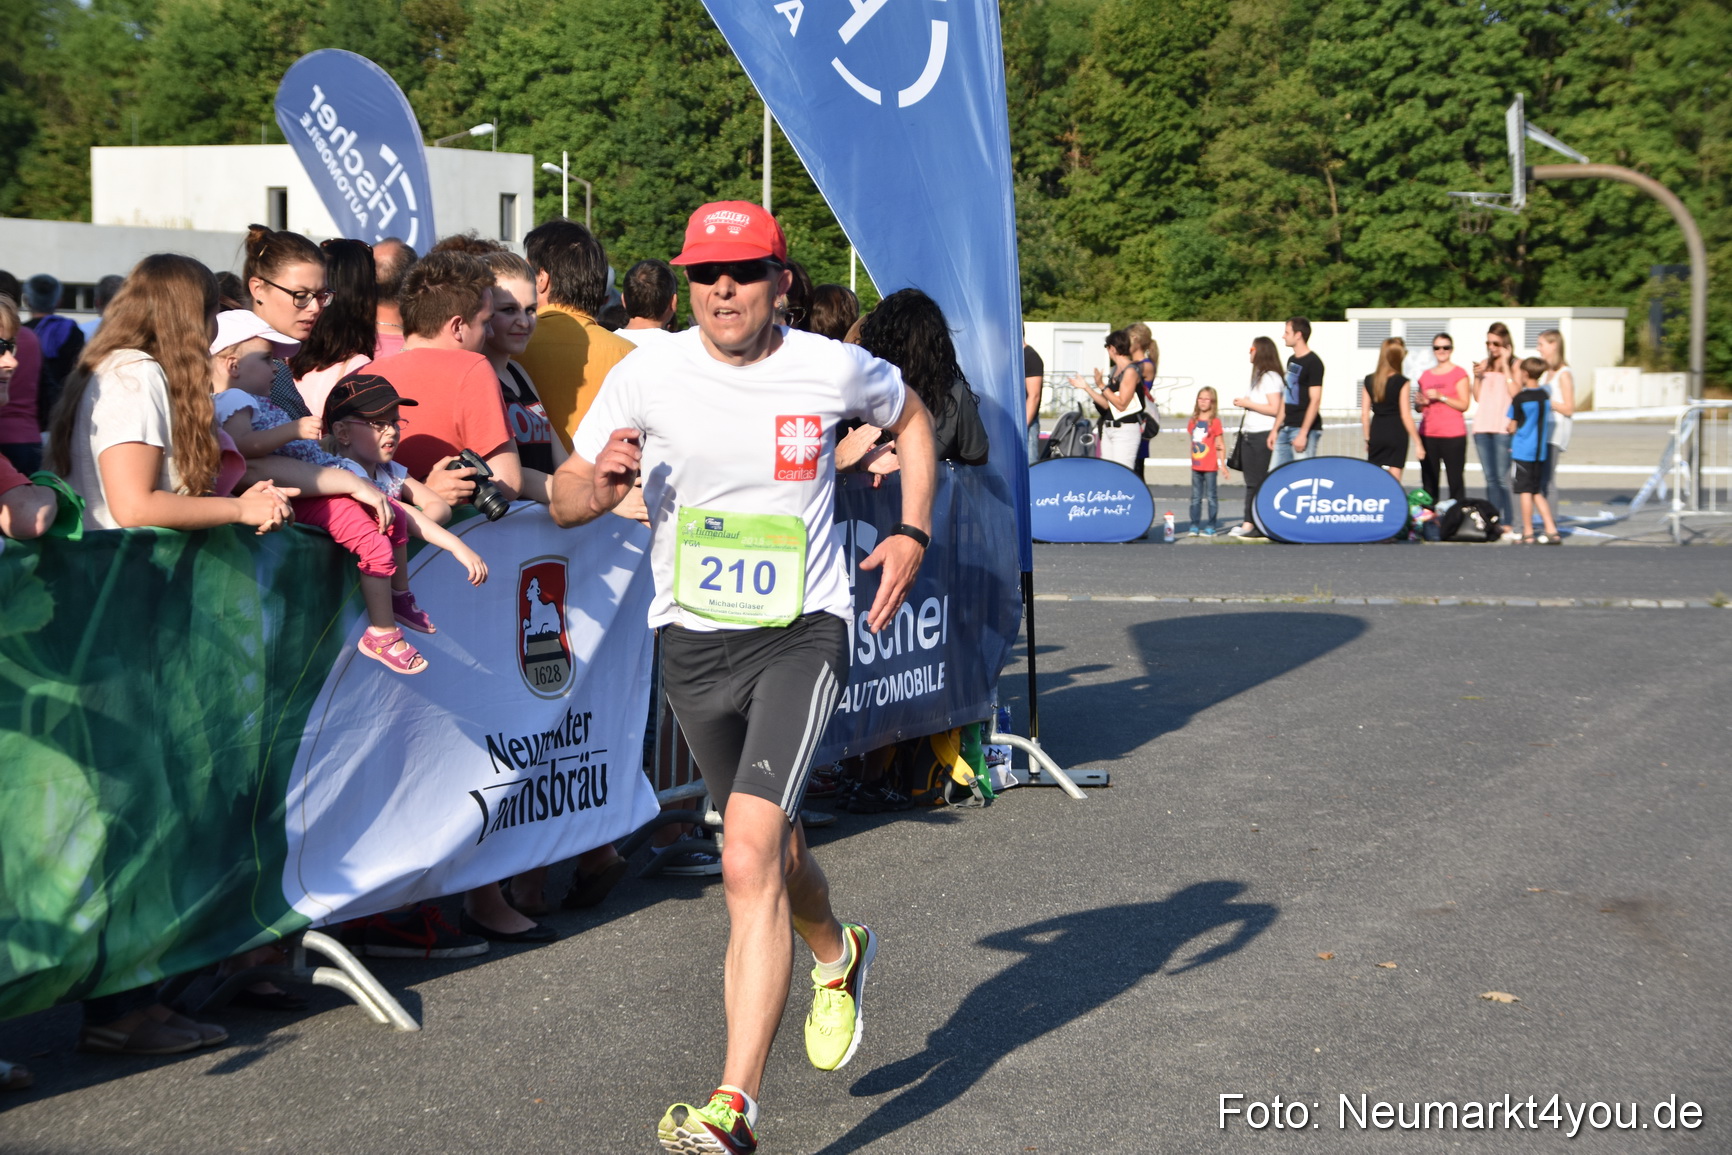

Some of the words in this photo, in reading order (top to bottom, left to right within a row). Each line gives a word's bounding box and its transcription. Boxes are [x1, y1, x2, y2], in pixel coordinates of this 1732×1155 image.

[777, 467, 816, 480] caritas
[1035, 493, 1060, 506] und
[1296, 494, 1390, 514] Fischer
[1305, 514, 1384, 524] AUTOMOBILE
[698, 555, 777, 596] 210
[708, 599, 738, 609] Michael
[738, 601, 765, 610] Glaser
[535, 664, 562, 686] 1628
[834, 661, 946, 715] AUTOMOBILE
